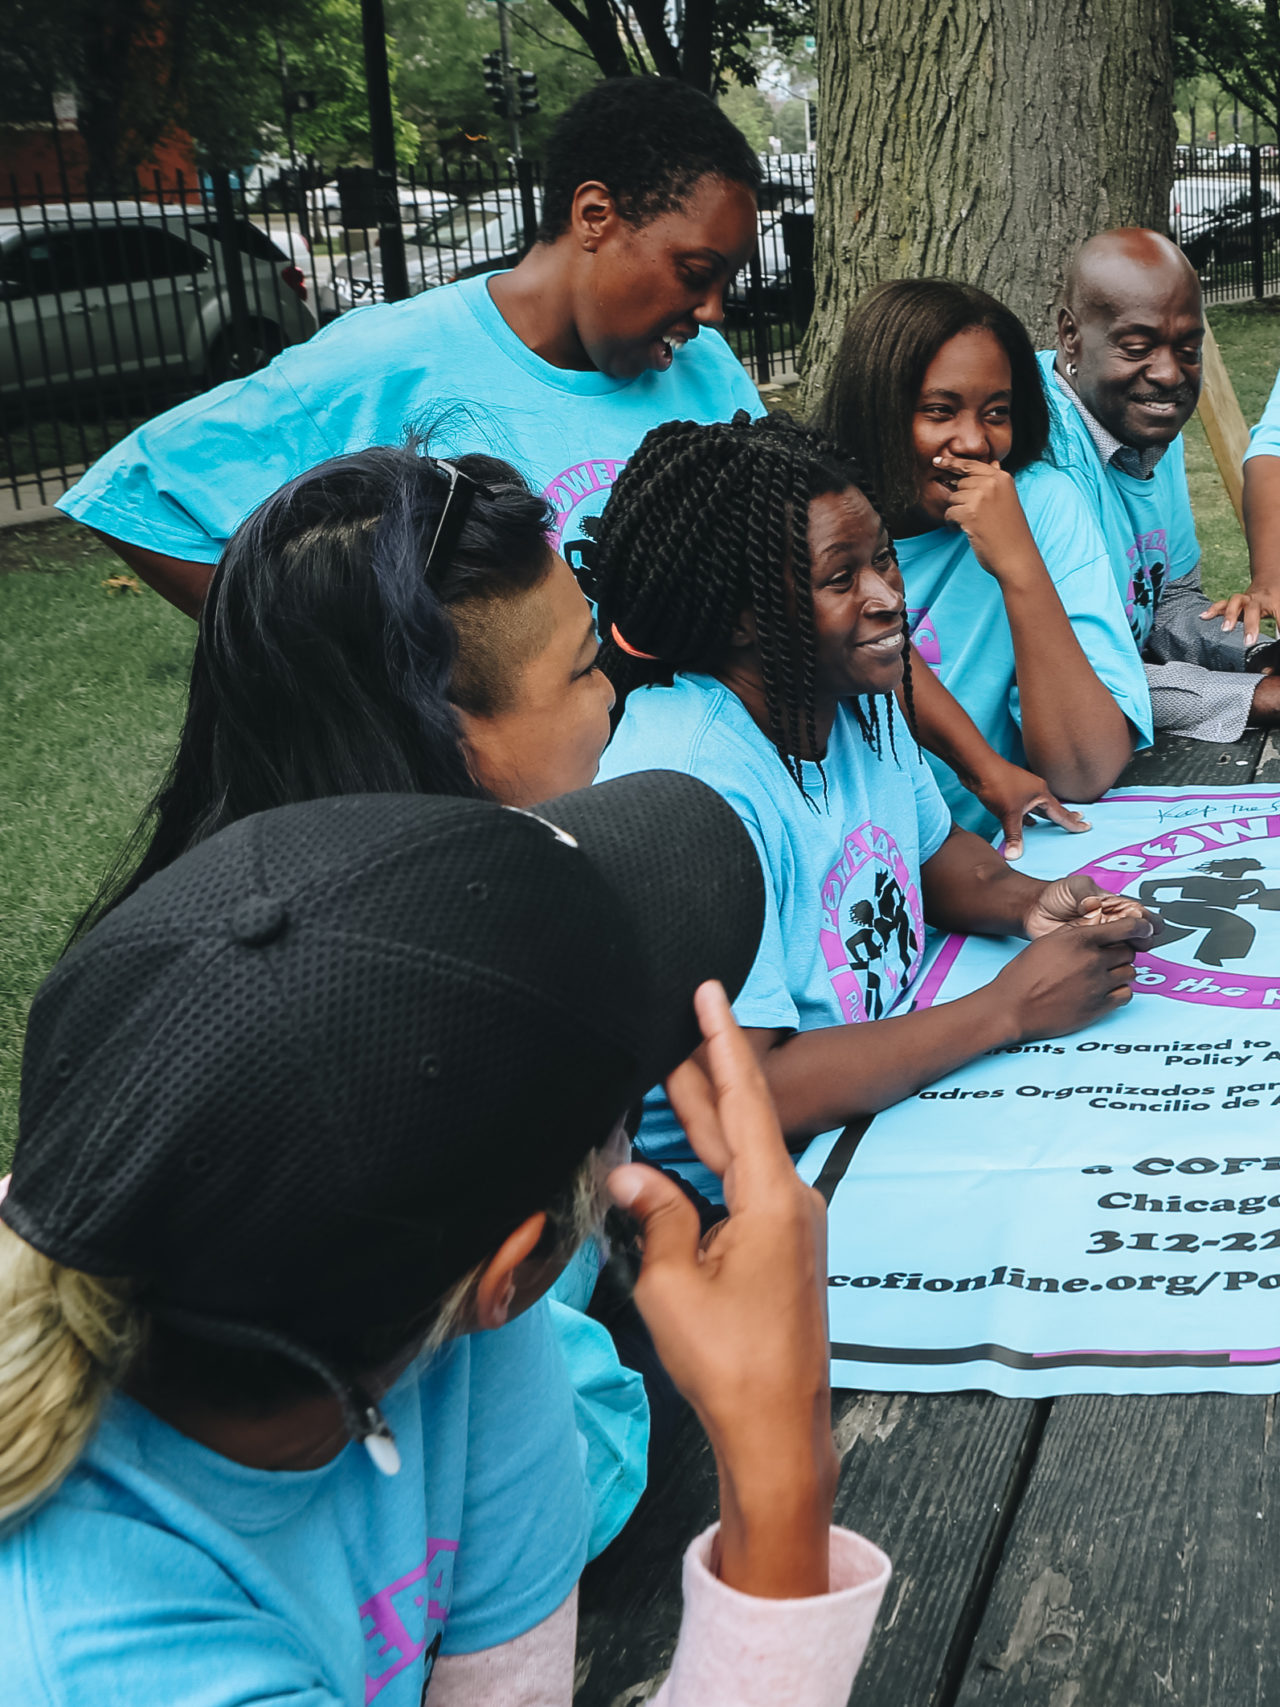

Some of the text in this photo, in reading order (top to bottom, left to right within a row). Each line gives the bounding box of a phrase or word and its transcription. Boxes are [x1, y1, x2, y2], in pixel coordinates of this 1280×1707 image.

[1171, 977, 1250, 998] the
[846, 991, 863, 1024] Plu
[1076, 1039, 1233, 1054] Organized
[1243, 1039, 1272, 1050] to
[1165, 1053, 1254, 1066] Policy
[1016, 1083, 1215, 1099] Organizados
[1089, 1098, 1211, 1112] Concilio
[1221, 1096, 1260, 1109] de
[1081, 1165, 1114, 1174] a
